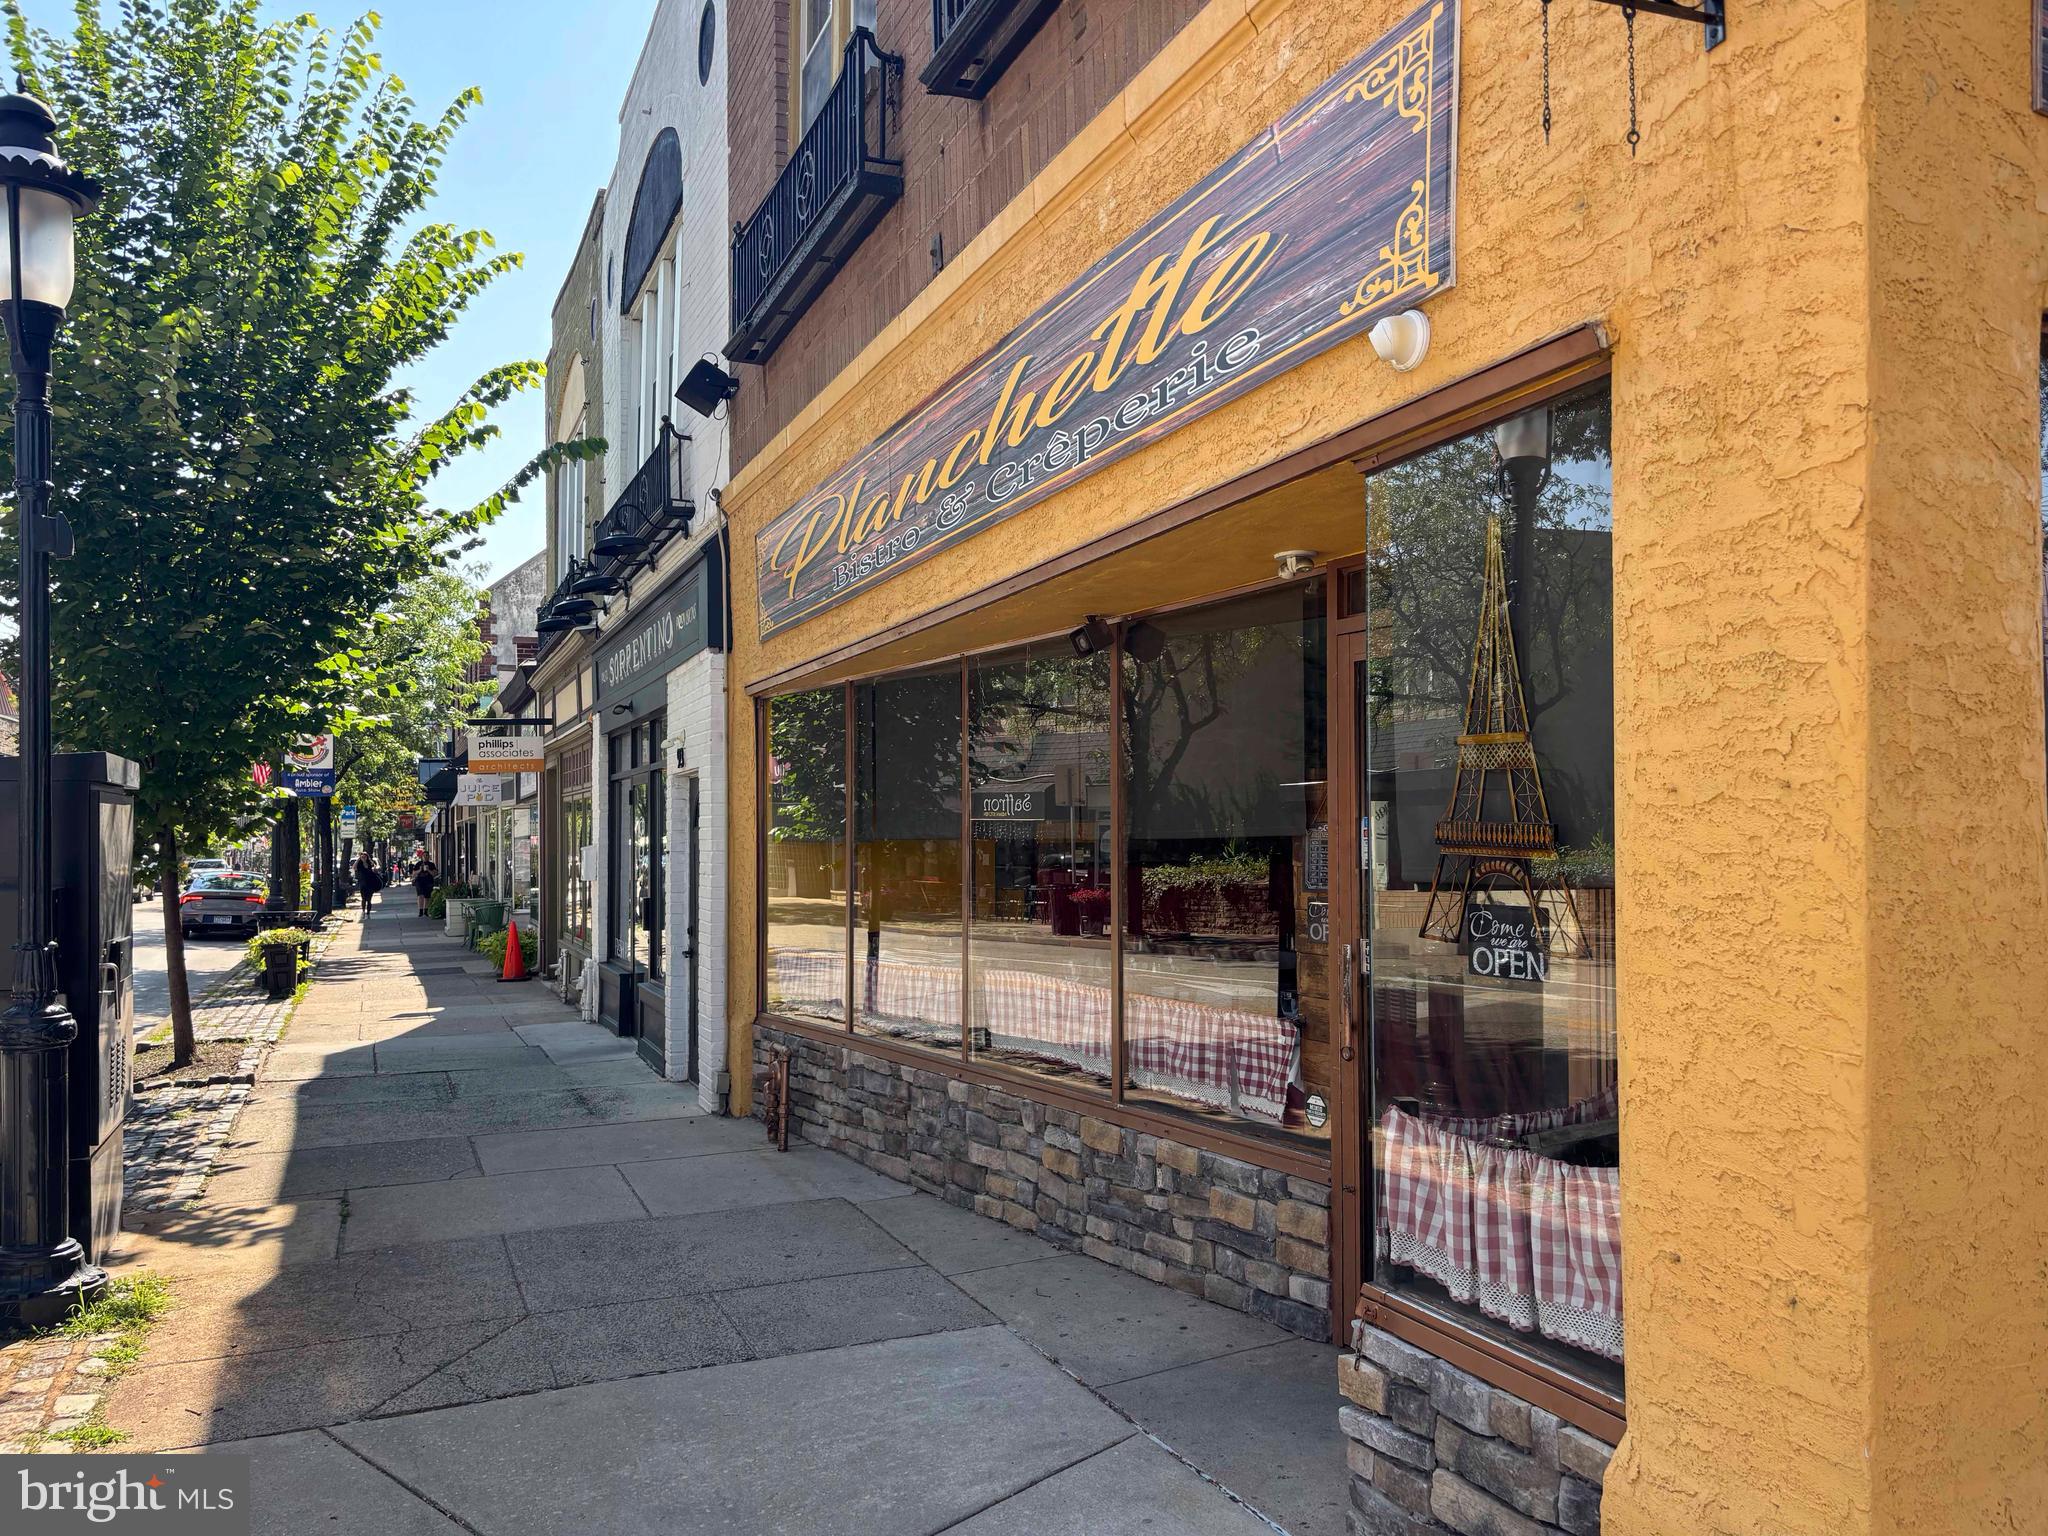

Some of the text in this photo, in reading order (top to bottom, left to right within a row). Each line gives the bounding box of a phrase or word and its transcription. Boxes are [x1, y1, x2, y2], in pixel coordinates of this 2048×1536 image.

[771, 172, 1311, 599] Planchette
[832, 326, 1261, 591] Bistro & Crêperie
[608, 611, 675, 687] SORRENTINO
[478, 739, 514, 750] phillips
[478, 749, 535, 758] associates
[479, 762, 536, 771] architects
[294, 778, 323, 788] Ambler
[460, 784, 501, 793] JUICE
[1469, 911, 1526, 939] Come
[1490, 936, 1529, 949] we are
[1472, 946, 1545, 981] OPEN
